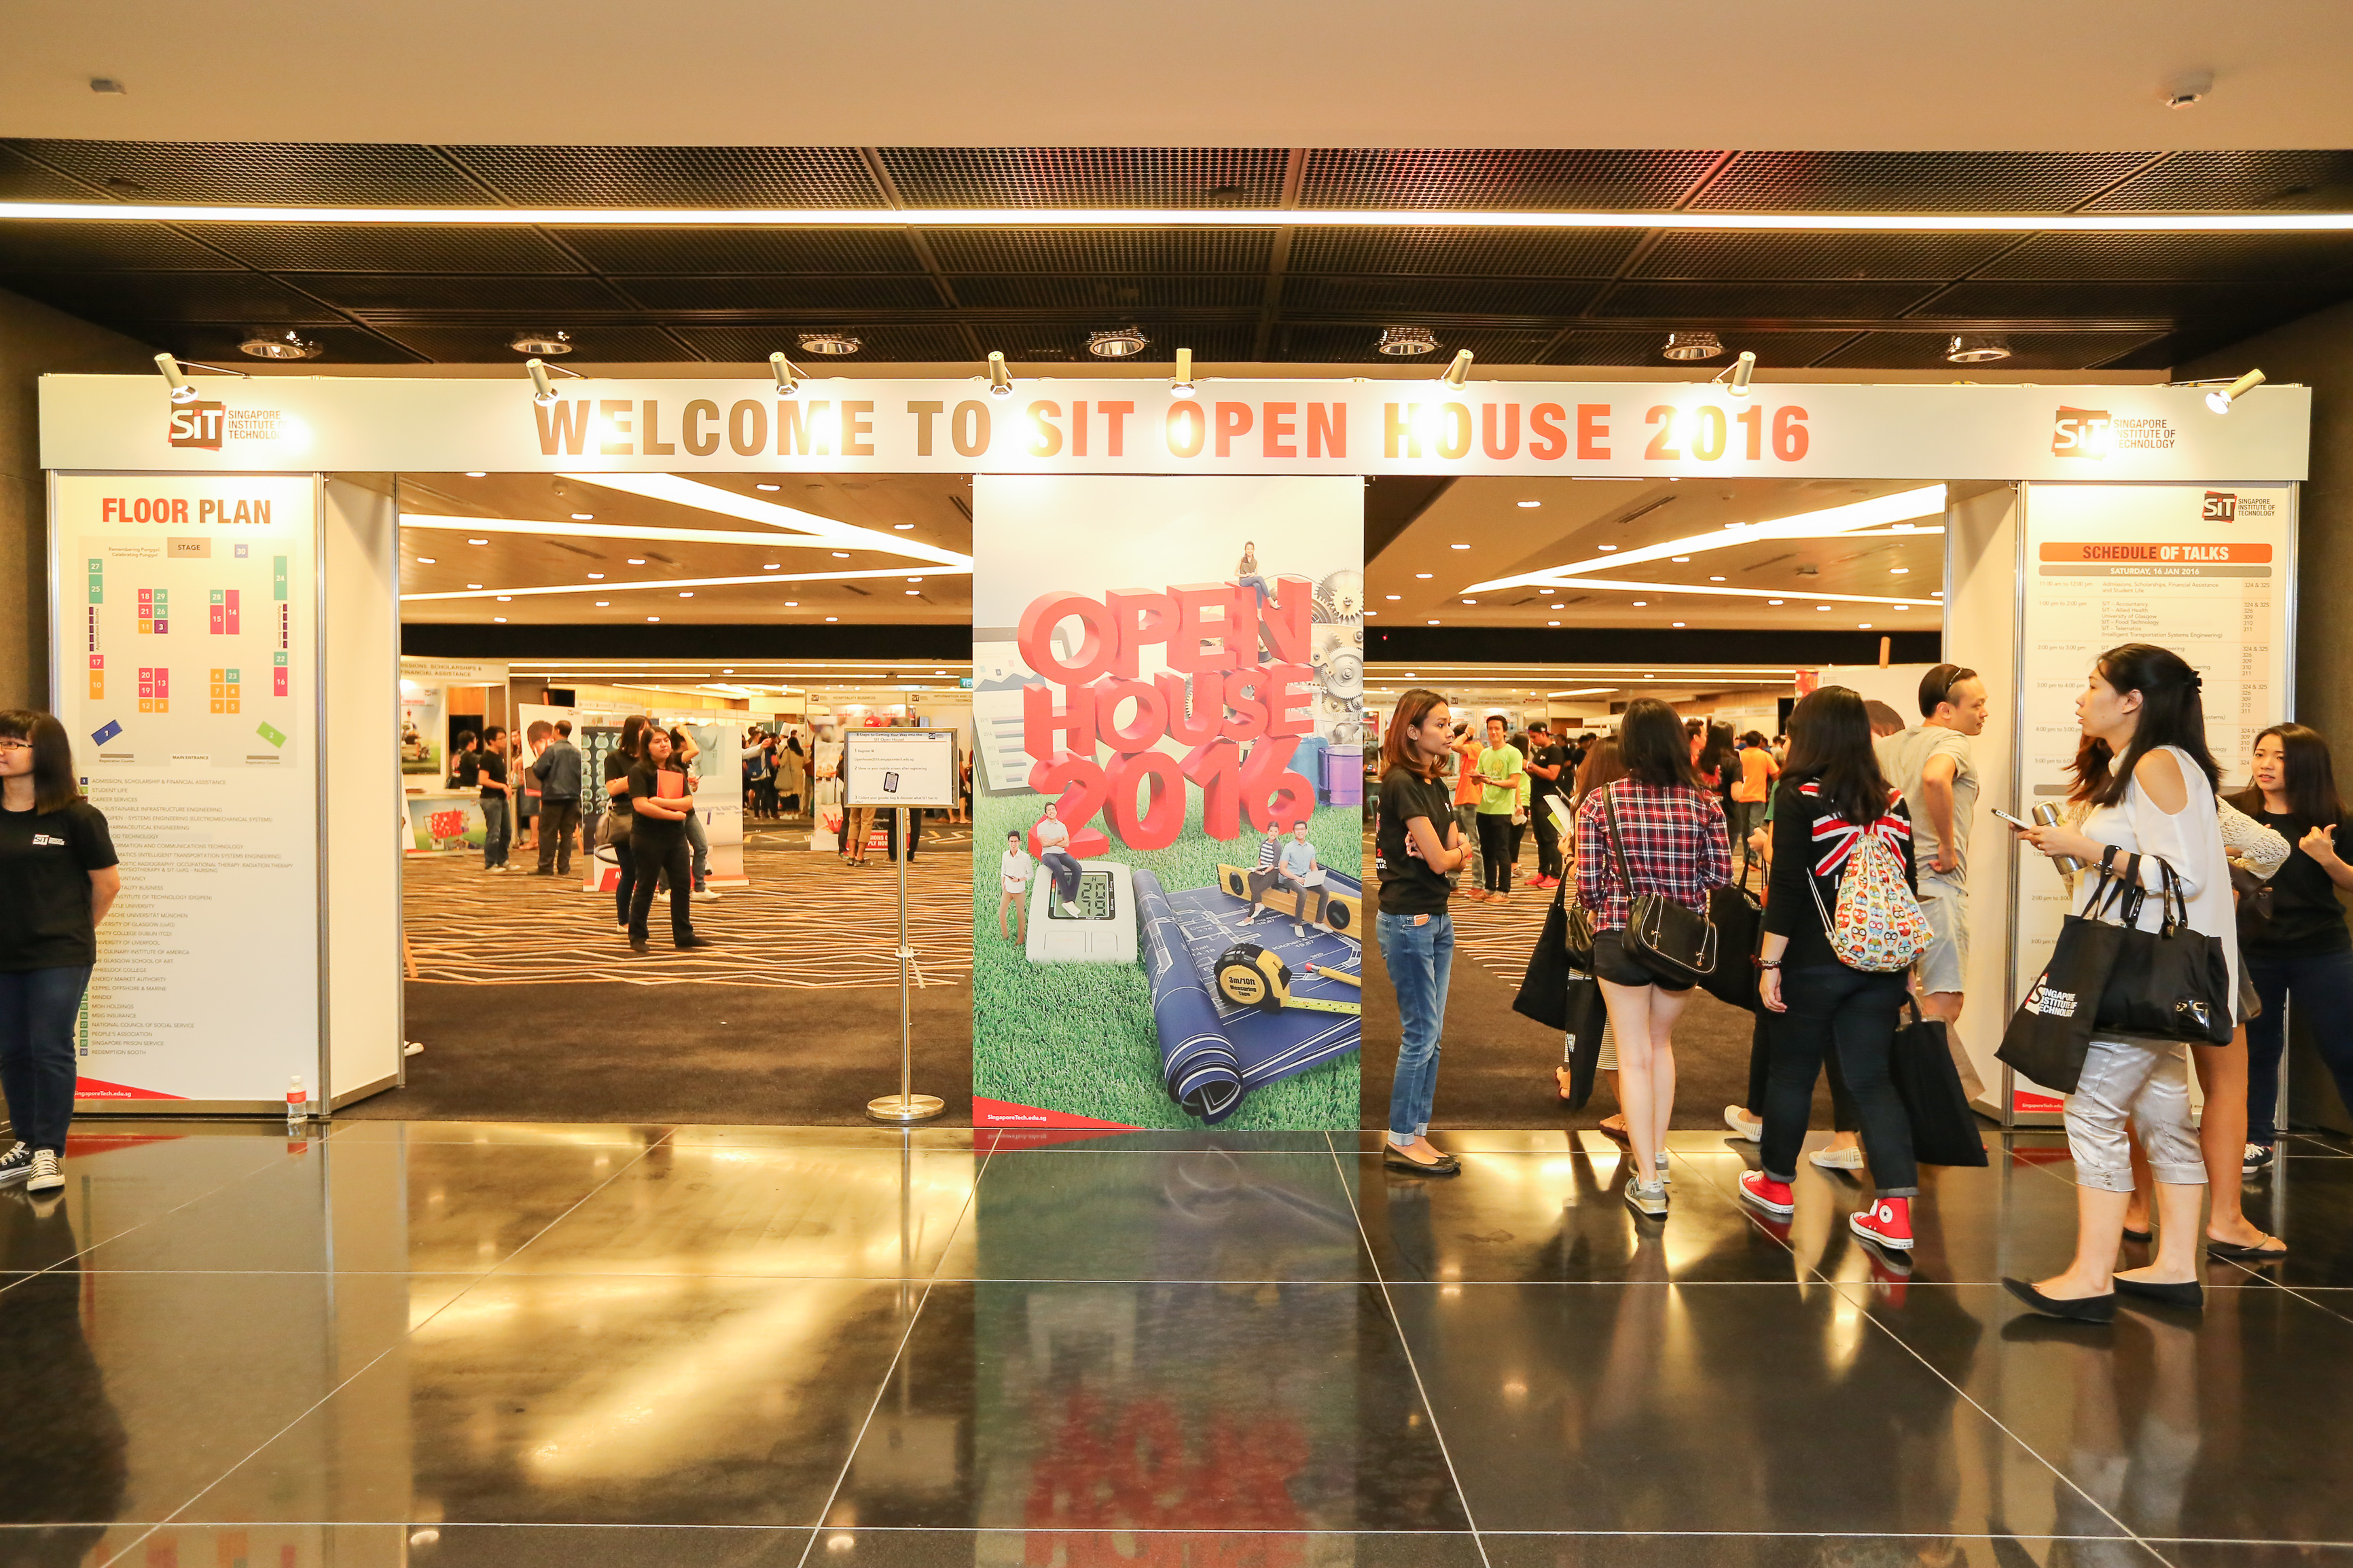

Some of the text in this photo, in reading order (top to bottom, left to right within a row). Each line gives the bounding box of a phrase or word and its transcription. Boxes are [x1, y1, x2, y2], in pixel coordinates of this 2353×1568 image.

[229, 410, 281, 419] SINGAPORE
[229, 420, 274, 429] INSTITUTE
[2114, 419, 2167, 428] SINGAPORE
[229, 431, 282, 439] TECHNOLO
[534, 399, 1810, 462] WELCOME TO SIT OPEN HOUSE 2016
[2114, 429, 2176, 439] NSTITUTE OF
[2115, 439, 2174, 449] ECHNOLOGY
[103, 498, 270, 524] FLOOR PLAN
[2083, 546, 2228, 560] SCHEDULE OF TALKS
[1018, 577, 1312, 686] OPEN
[1024, 663, 1314, 761] HOUSE
[1028, 734, 1315, 862] 2016
[1272, 939, 1301, 950] Kitchen
[1229, 977, 1255, 985] 3m/10ft
